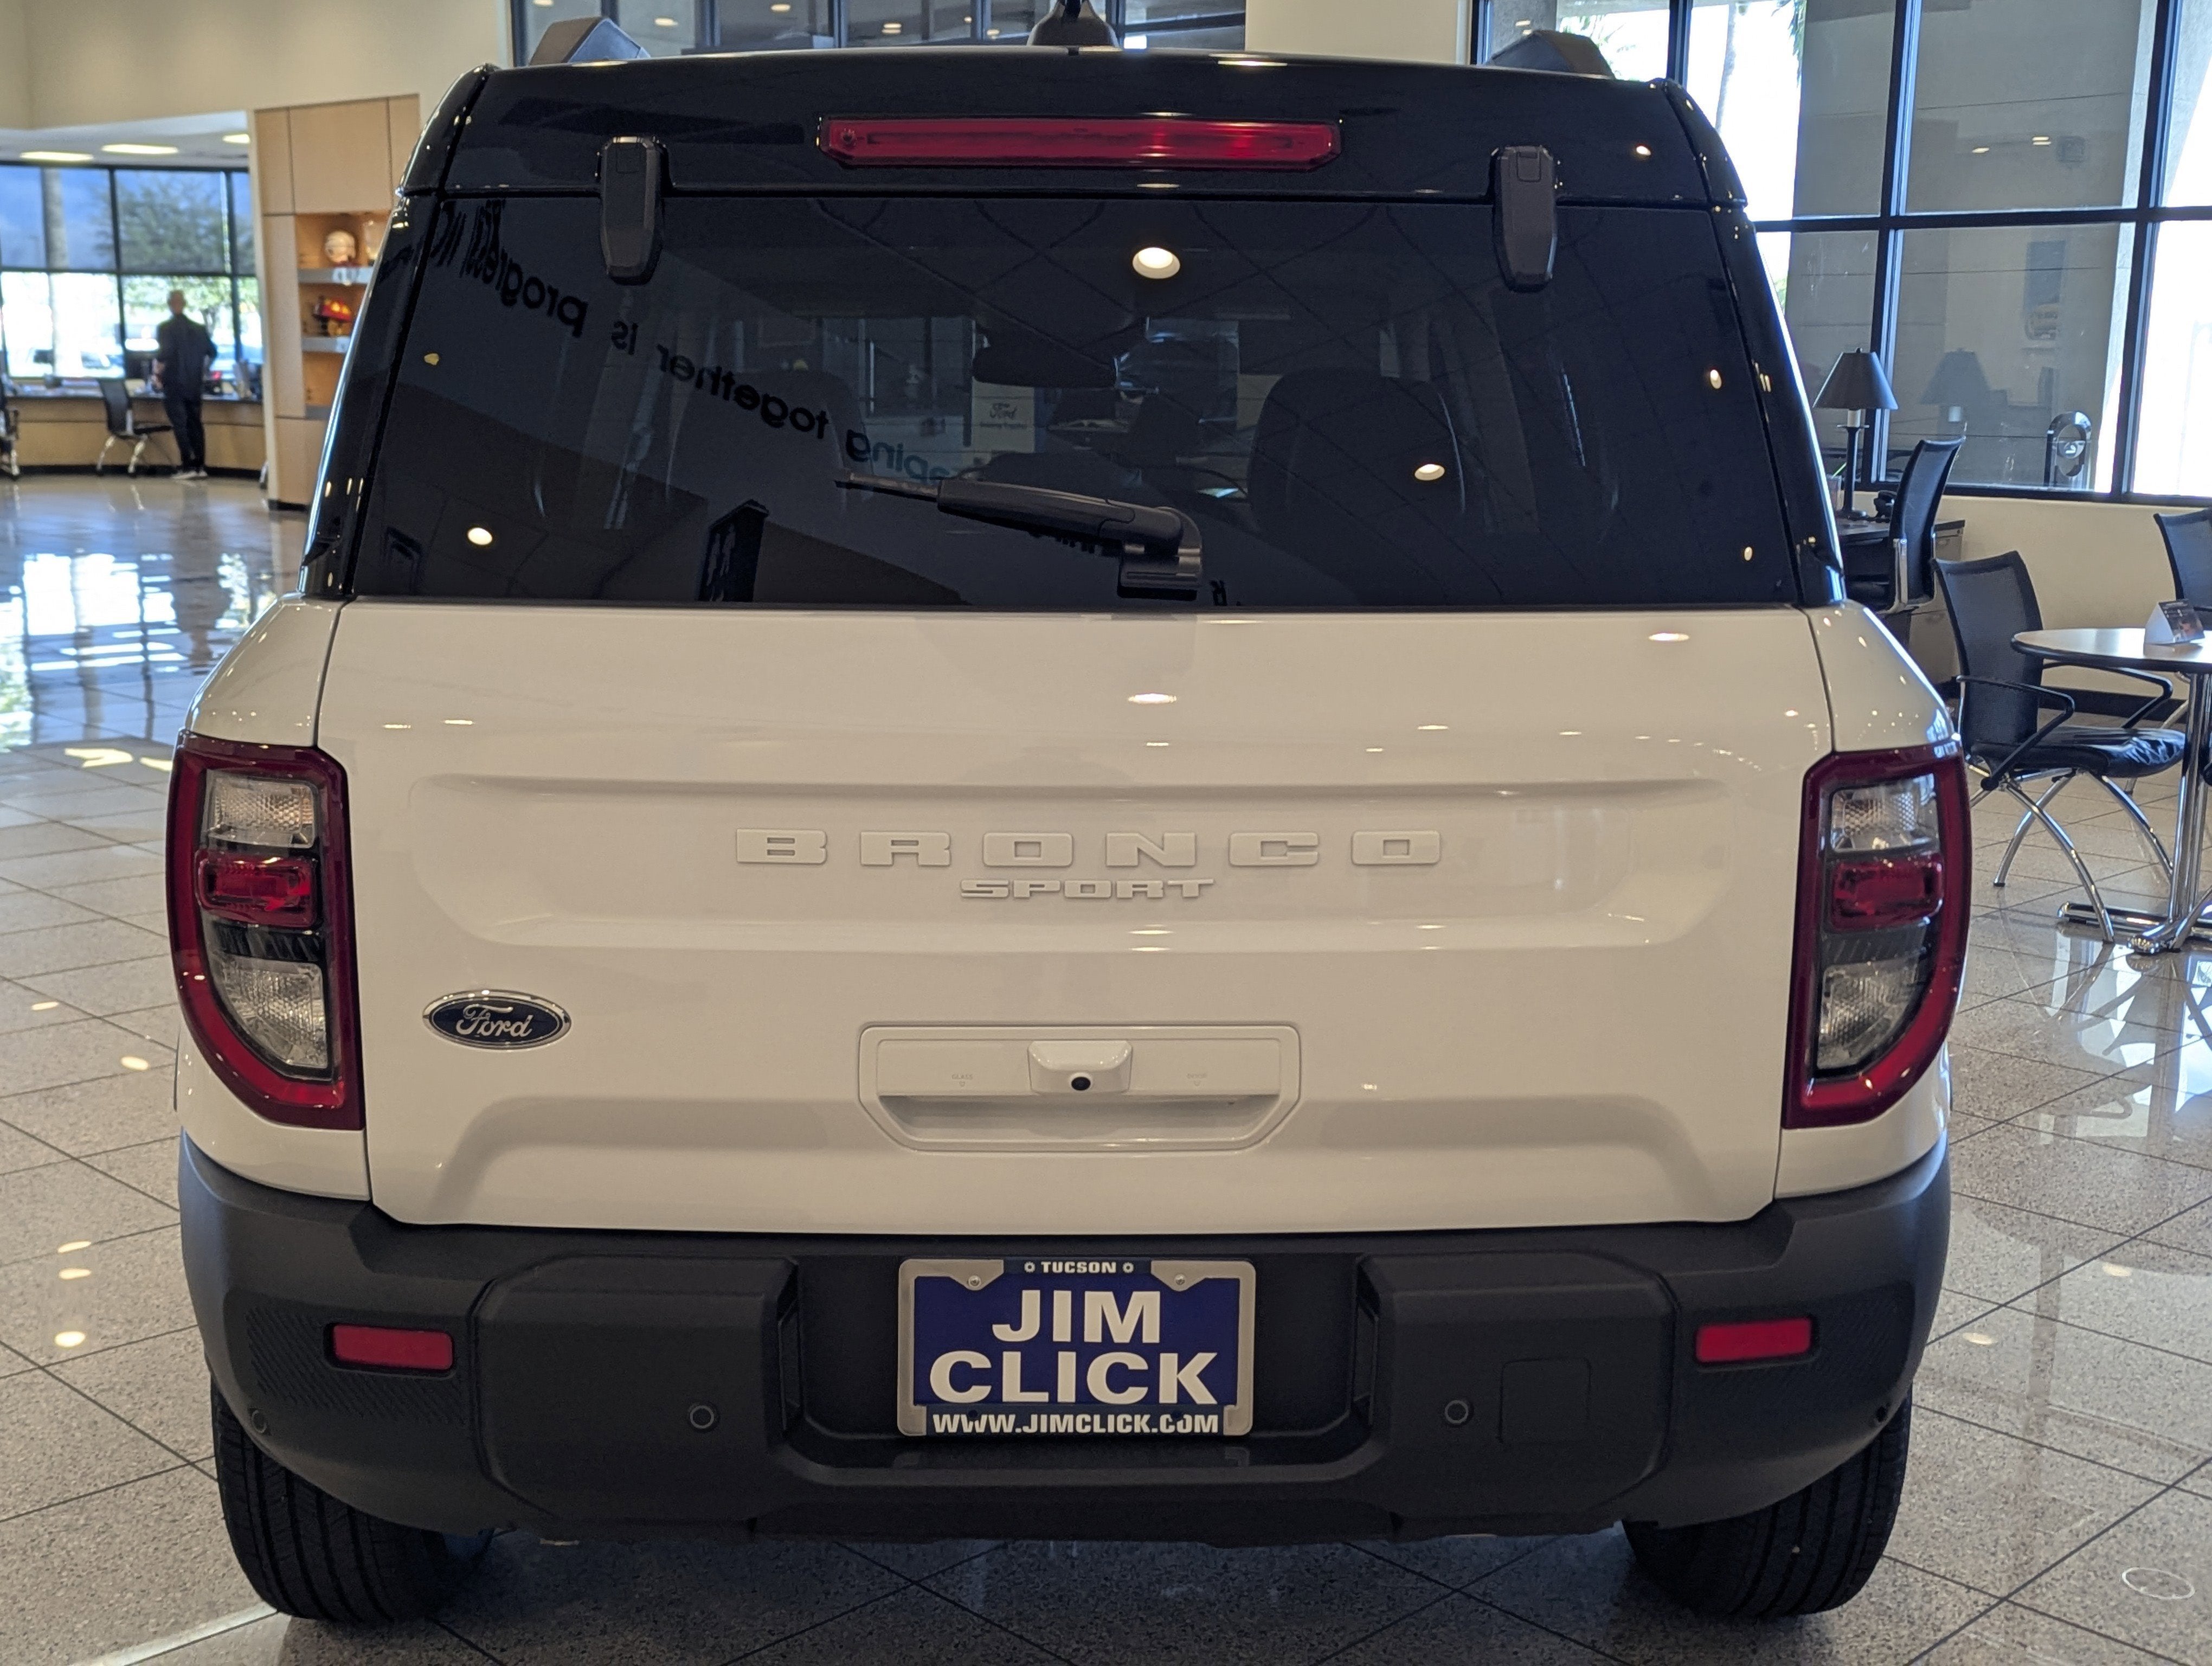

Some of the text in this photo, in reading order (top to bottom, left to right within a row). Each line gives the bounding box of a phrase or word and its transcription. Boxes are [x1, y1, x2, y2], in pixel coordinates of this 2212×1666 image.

[736, 828, 1441, 868] BRONCO
[960, 878, 1214, 899] SPORT
[455, 1003, 533, 1037] Ford
[1041, 1261, 1117, 1274] TUCSON
[992, 1289, 1161, 1344] JIM
[929, 1350, 1218, 1405] CLICK
[932, 1414, 1219, 1433] WWW.JIMCLICK.COM
